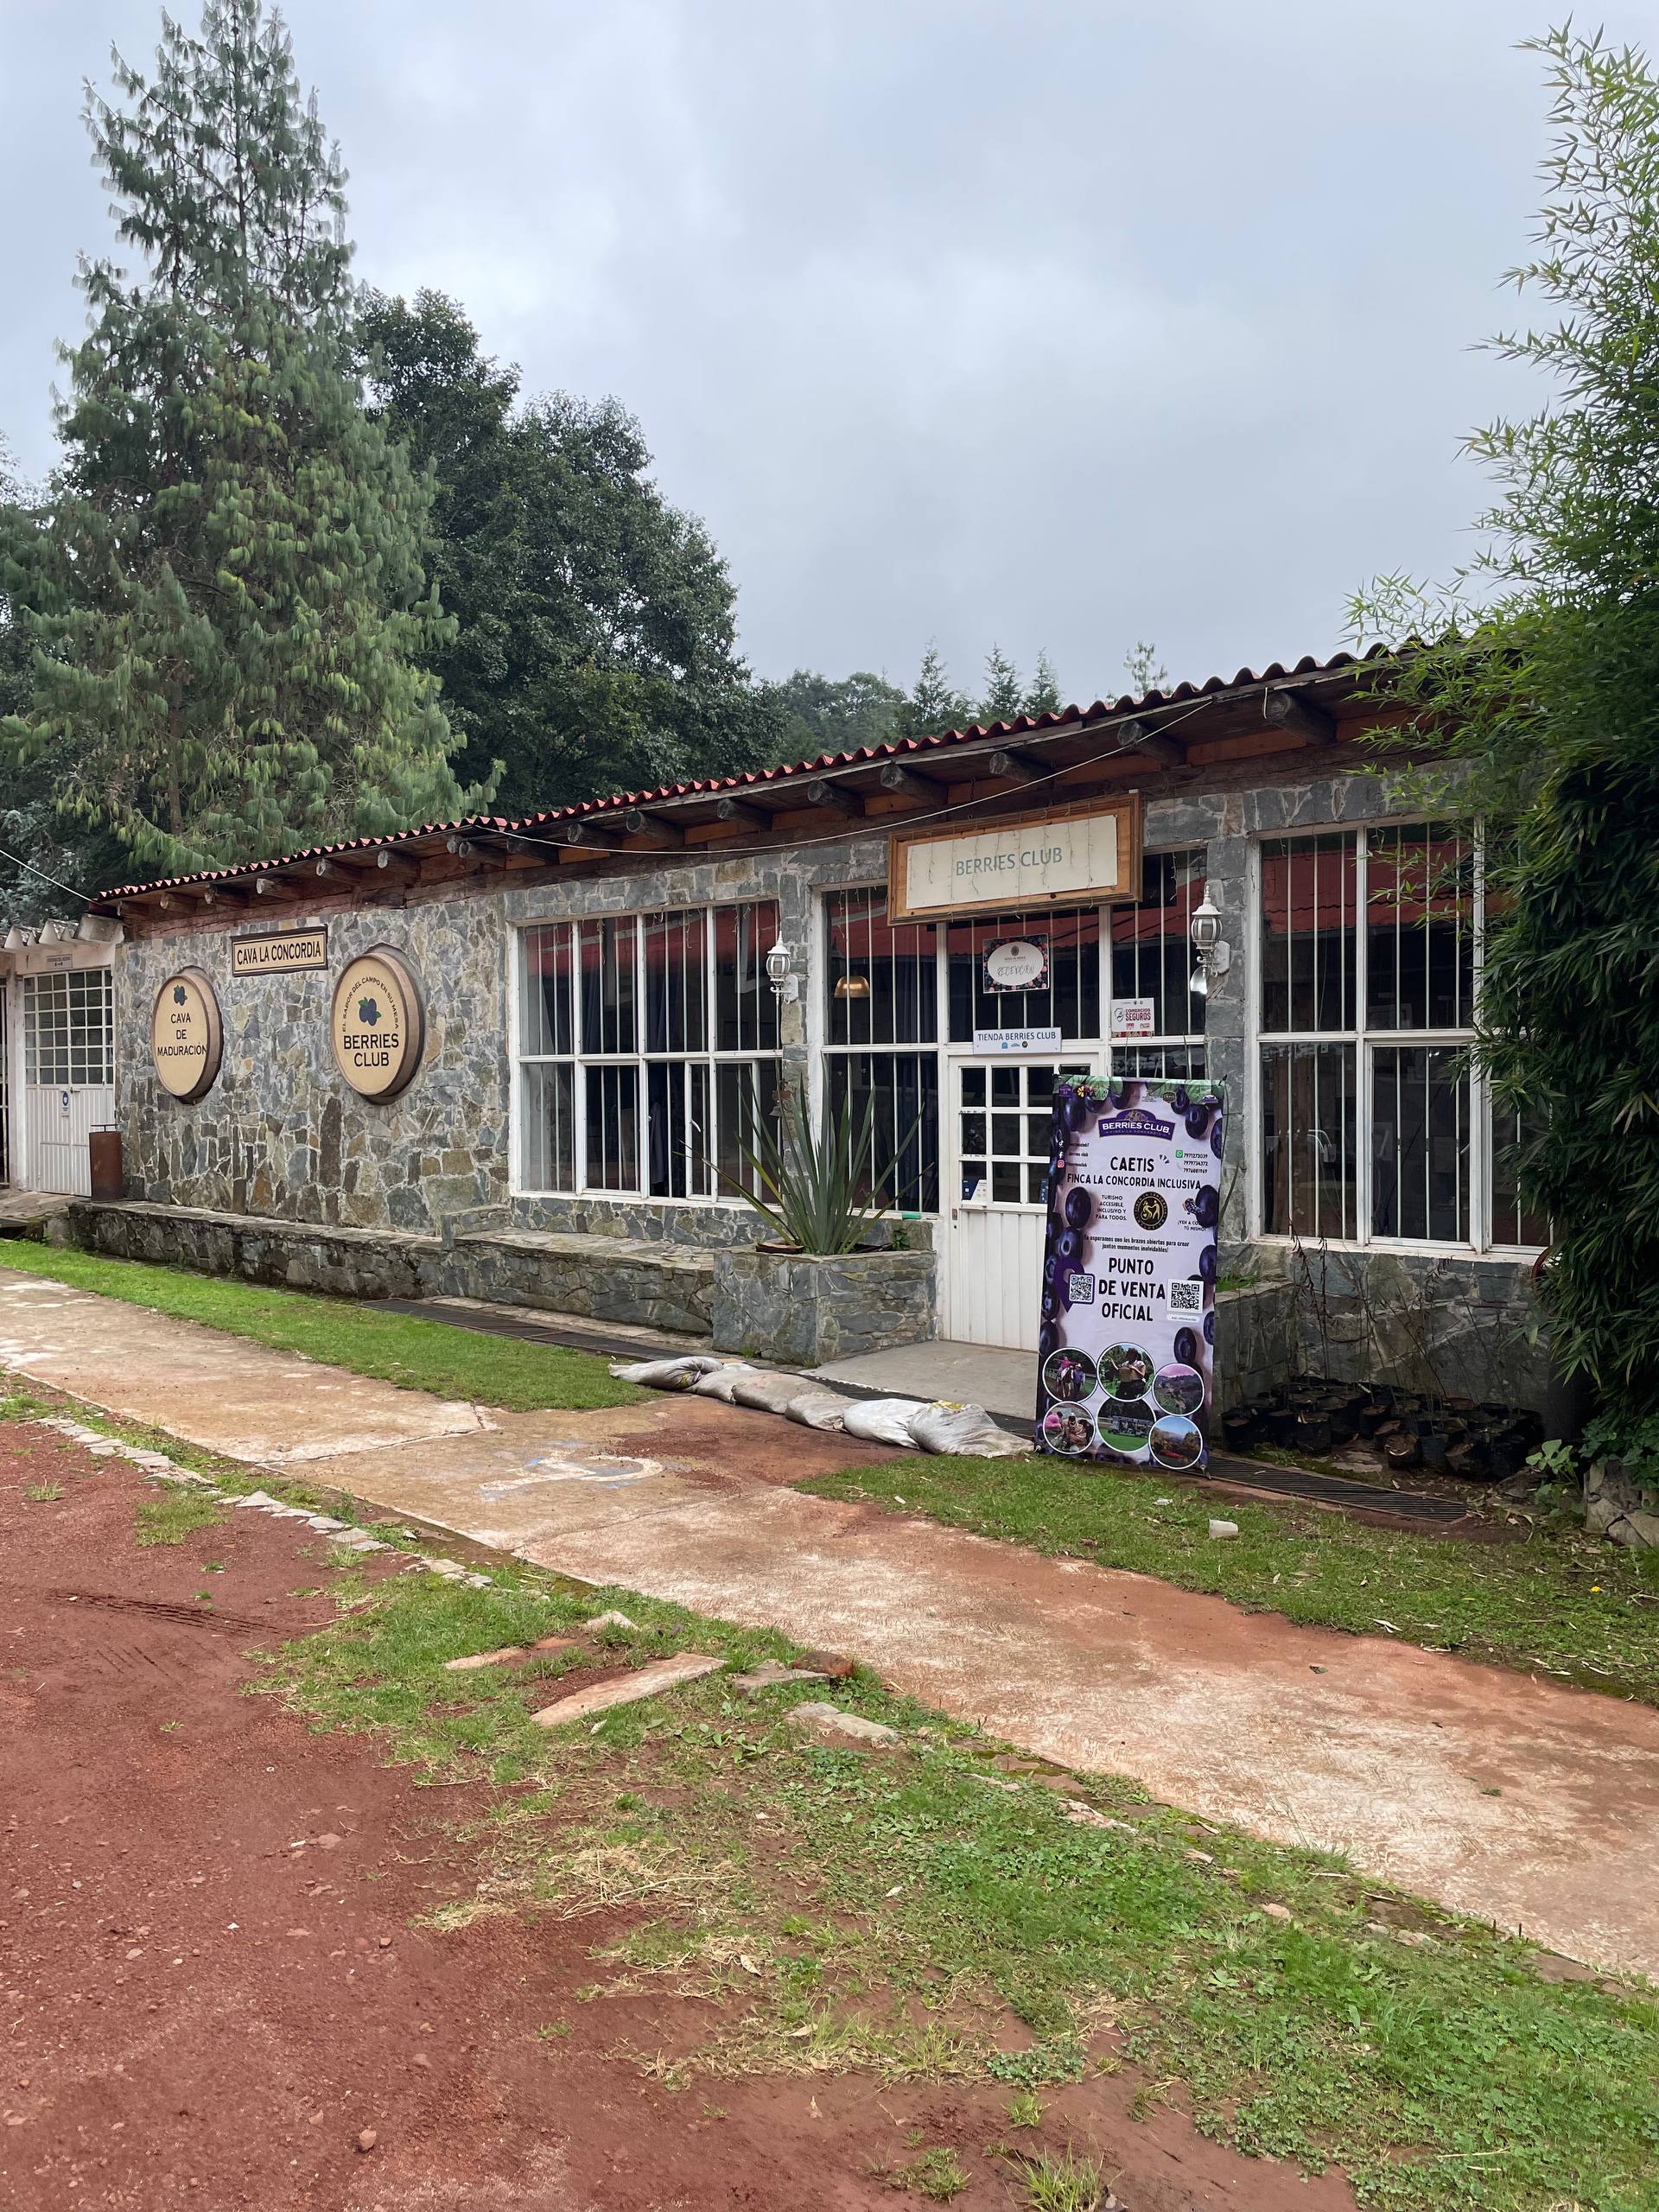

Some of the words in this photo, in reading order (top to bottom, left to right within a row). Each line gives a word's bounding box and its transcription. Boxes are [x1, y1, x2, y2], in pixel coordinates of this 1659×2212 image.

[956, 854, 1015, 875] BERRIES
[1020, 847, 1062, 867] CLUB
[237, 948, 257, 965] CAVA
[259, 946, 270, 963] LA
[271, 941, 321, 961] CONCORDIA
[352, 982, 362, 993] DEL
[361, 976, 380, 986] CAMPO
[380, 983, 388, 994] EN
[387, 992, 394, 1004] SU
[170, 1013, 191, 1024] CAVA
[176, 1029, 187, 1039] DE
[344, 1033, 399, 1049] BERRIES
[1006, 1032, 1035, 1040] BERRIES
[157, 1041, 207, 1057] MADURACIÓN
[353, 1052, 389, 1067] CLUB
[1143, 1123, 1170, 1133] CLUB
[1110, 1156, 1154, 1173] CAETIS
[1067, 1173, 1090, 1184] FINCA
[1094, 1175, 1103, 1184] LA
[1106, 1175, 1155, 1187] CONCORDIA
[1157, 1178, 1201, 1190] INCLUSIVA
[1109, 1257, 1154, 1275] PUNTO
[1098, 1279, 1116, 1295] DE
[1121, 1281, 1166, 1300] VENTA
[1102, 1302, 1154, 1322] OFICIAL
